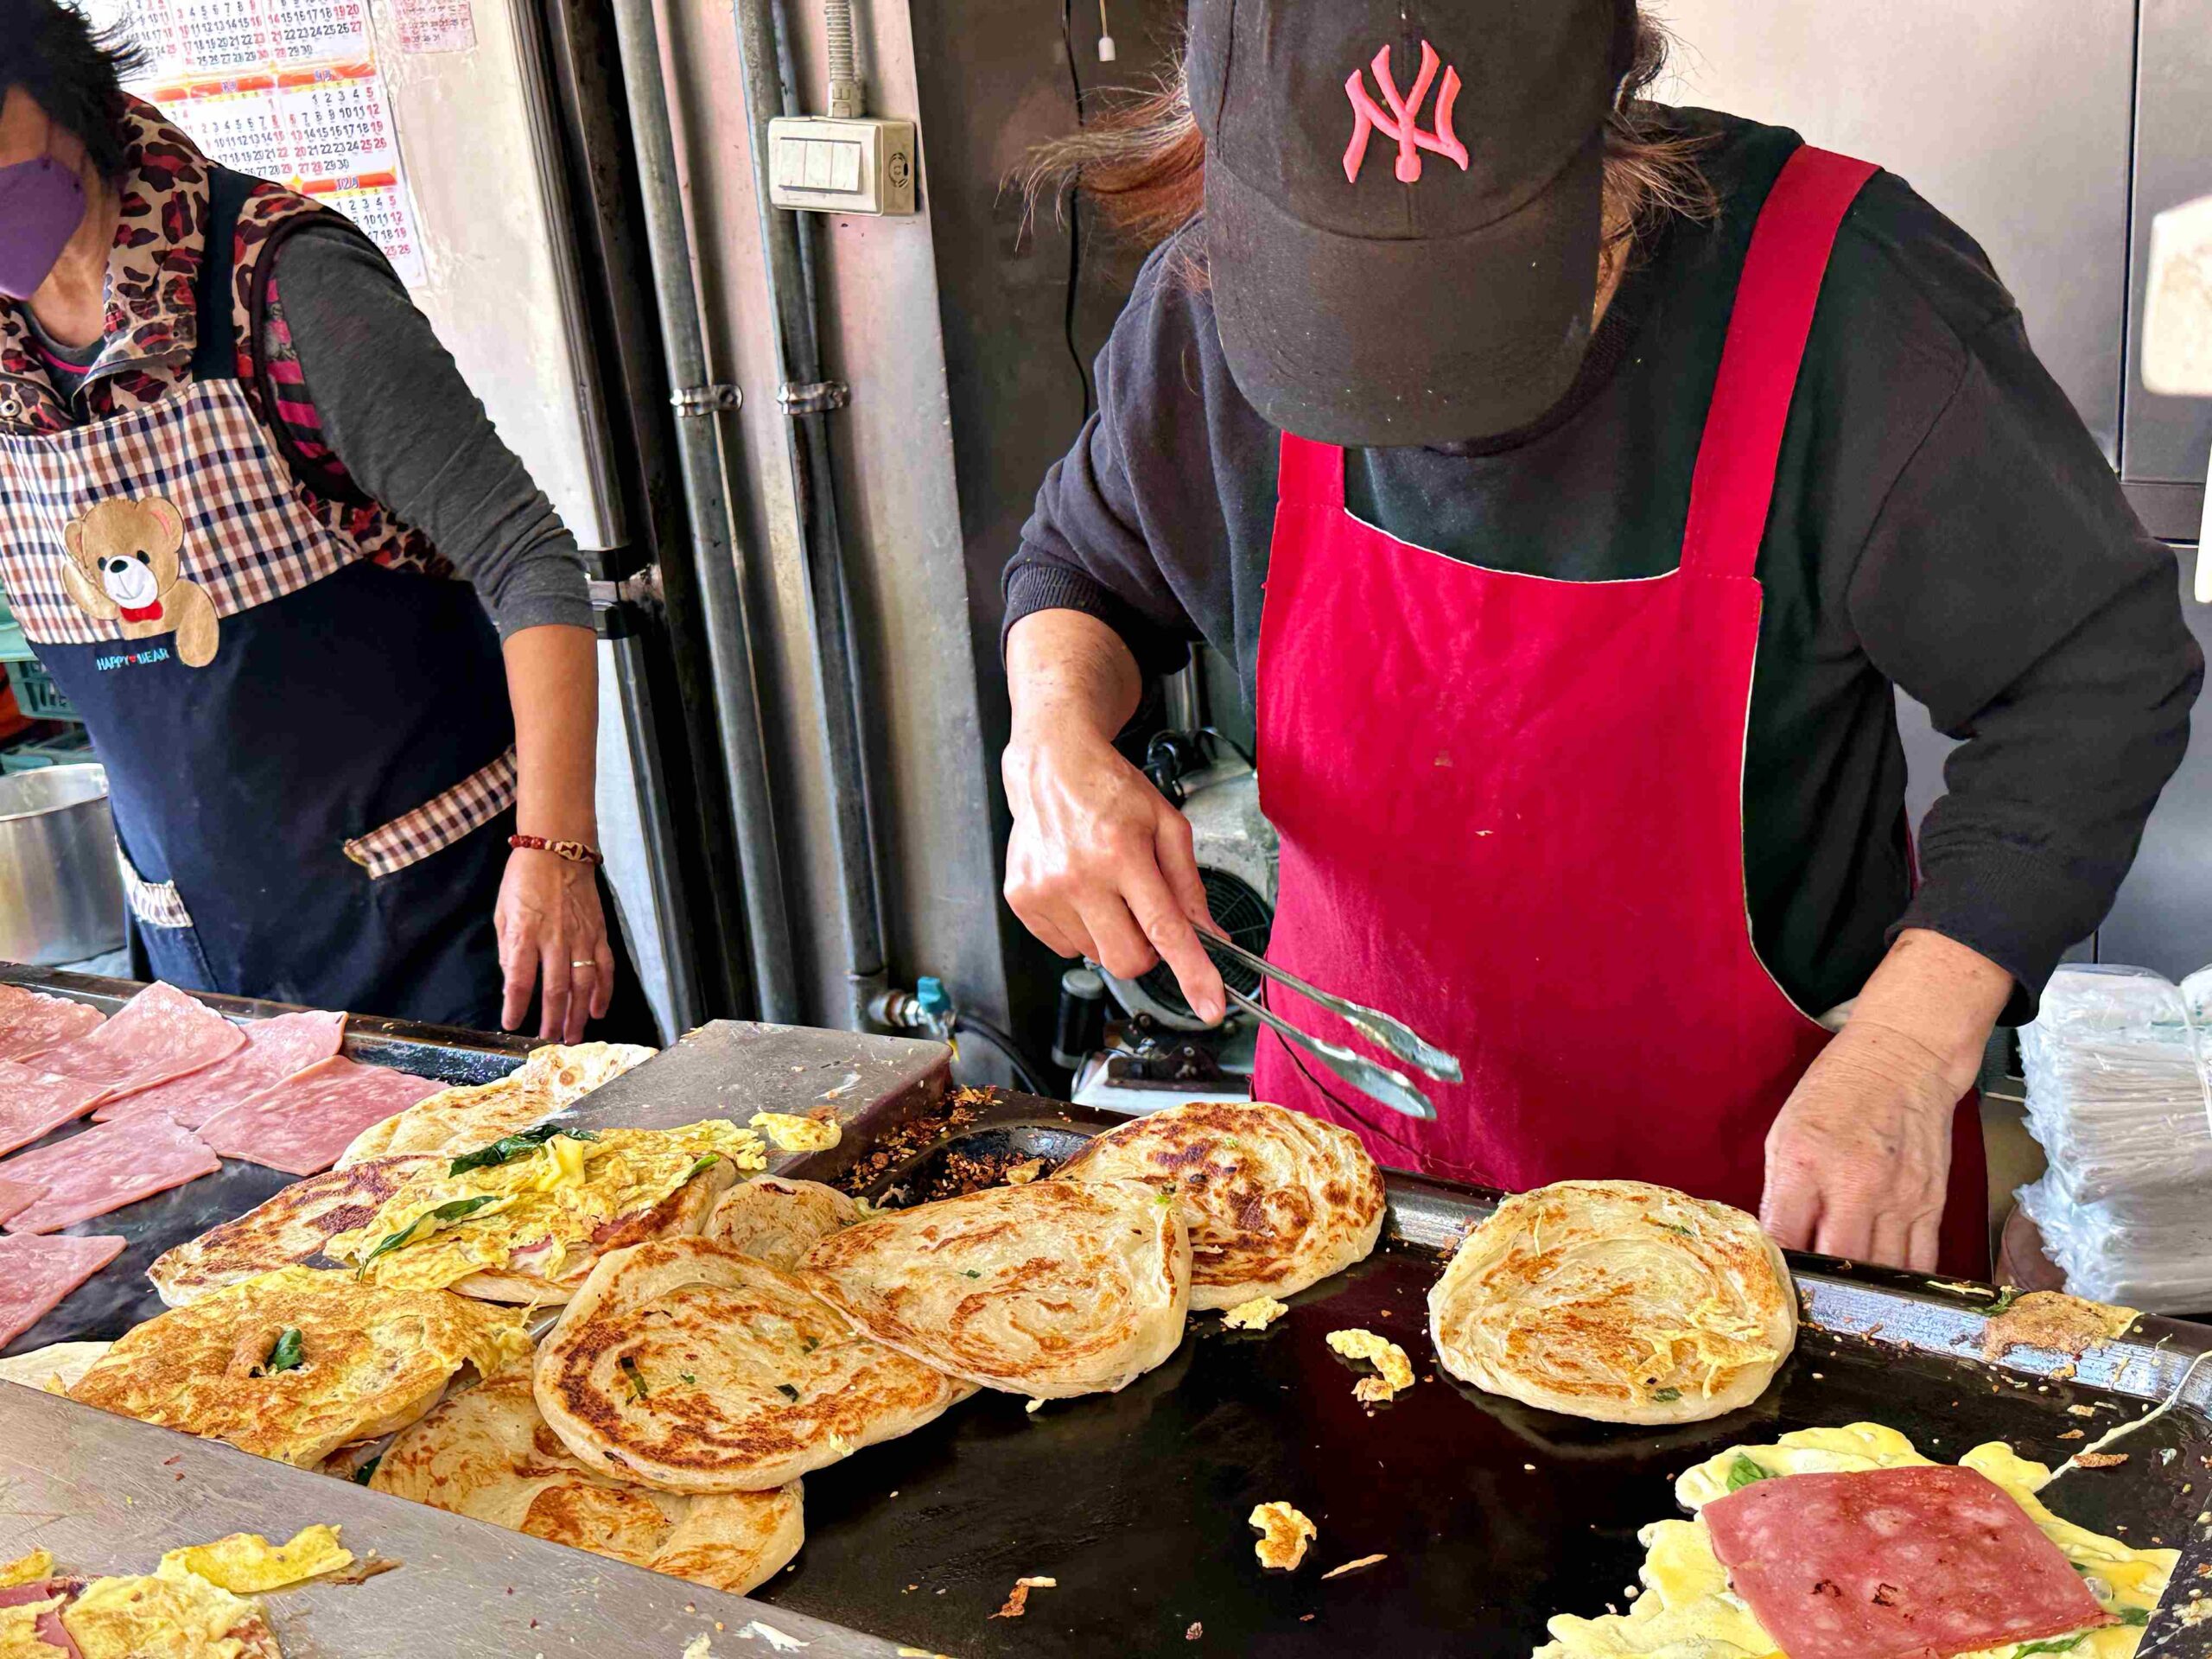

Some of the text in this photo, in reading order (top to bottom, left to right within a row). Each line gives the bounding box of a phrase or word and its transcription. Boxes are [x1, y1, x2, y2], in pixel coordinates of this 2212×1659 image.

[271, 21, 362, 41] 21 22 23 24 25 26 27
[313, 86, 374, 105] 1 2 3 4 5
[1342, 39, 1469, 184] NY
[290, 121, 384, 141] 13 14 15 16 17 18 19
[294, 137, 387, 157] 20 21 22 23 24 25 26
[298, 158, 350, 174] 27 28 29 30
[336, 195, 397, 213] 1 2 3 4 5
[380, 229, 393, 241] 18
[394, 227, 407, 239] 19
[96, 655, 130, 671] HAPPY
